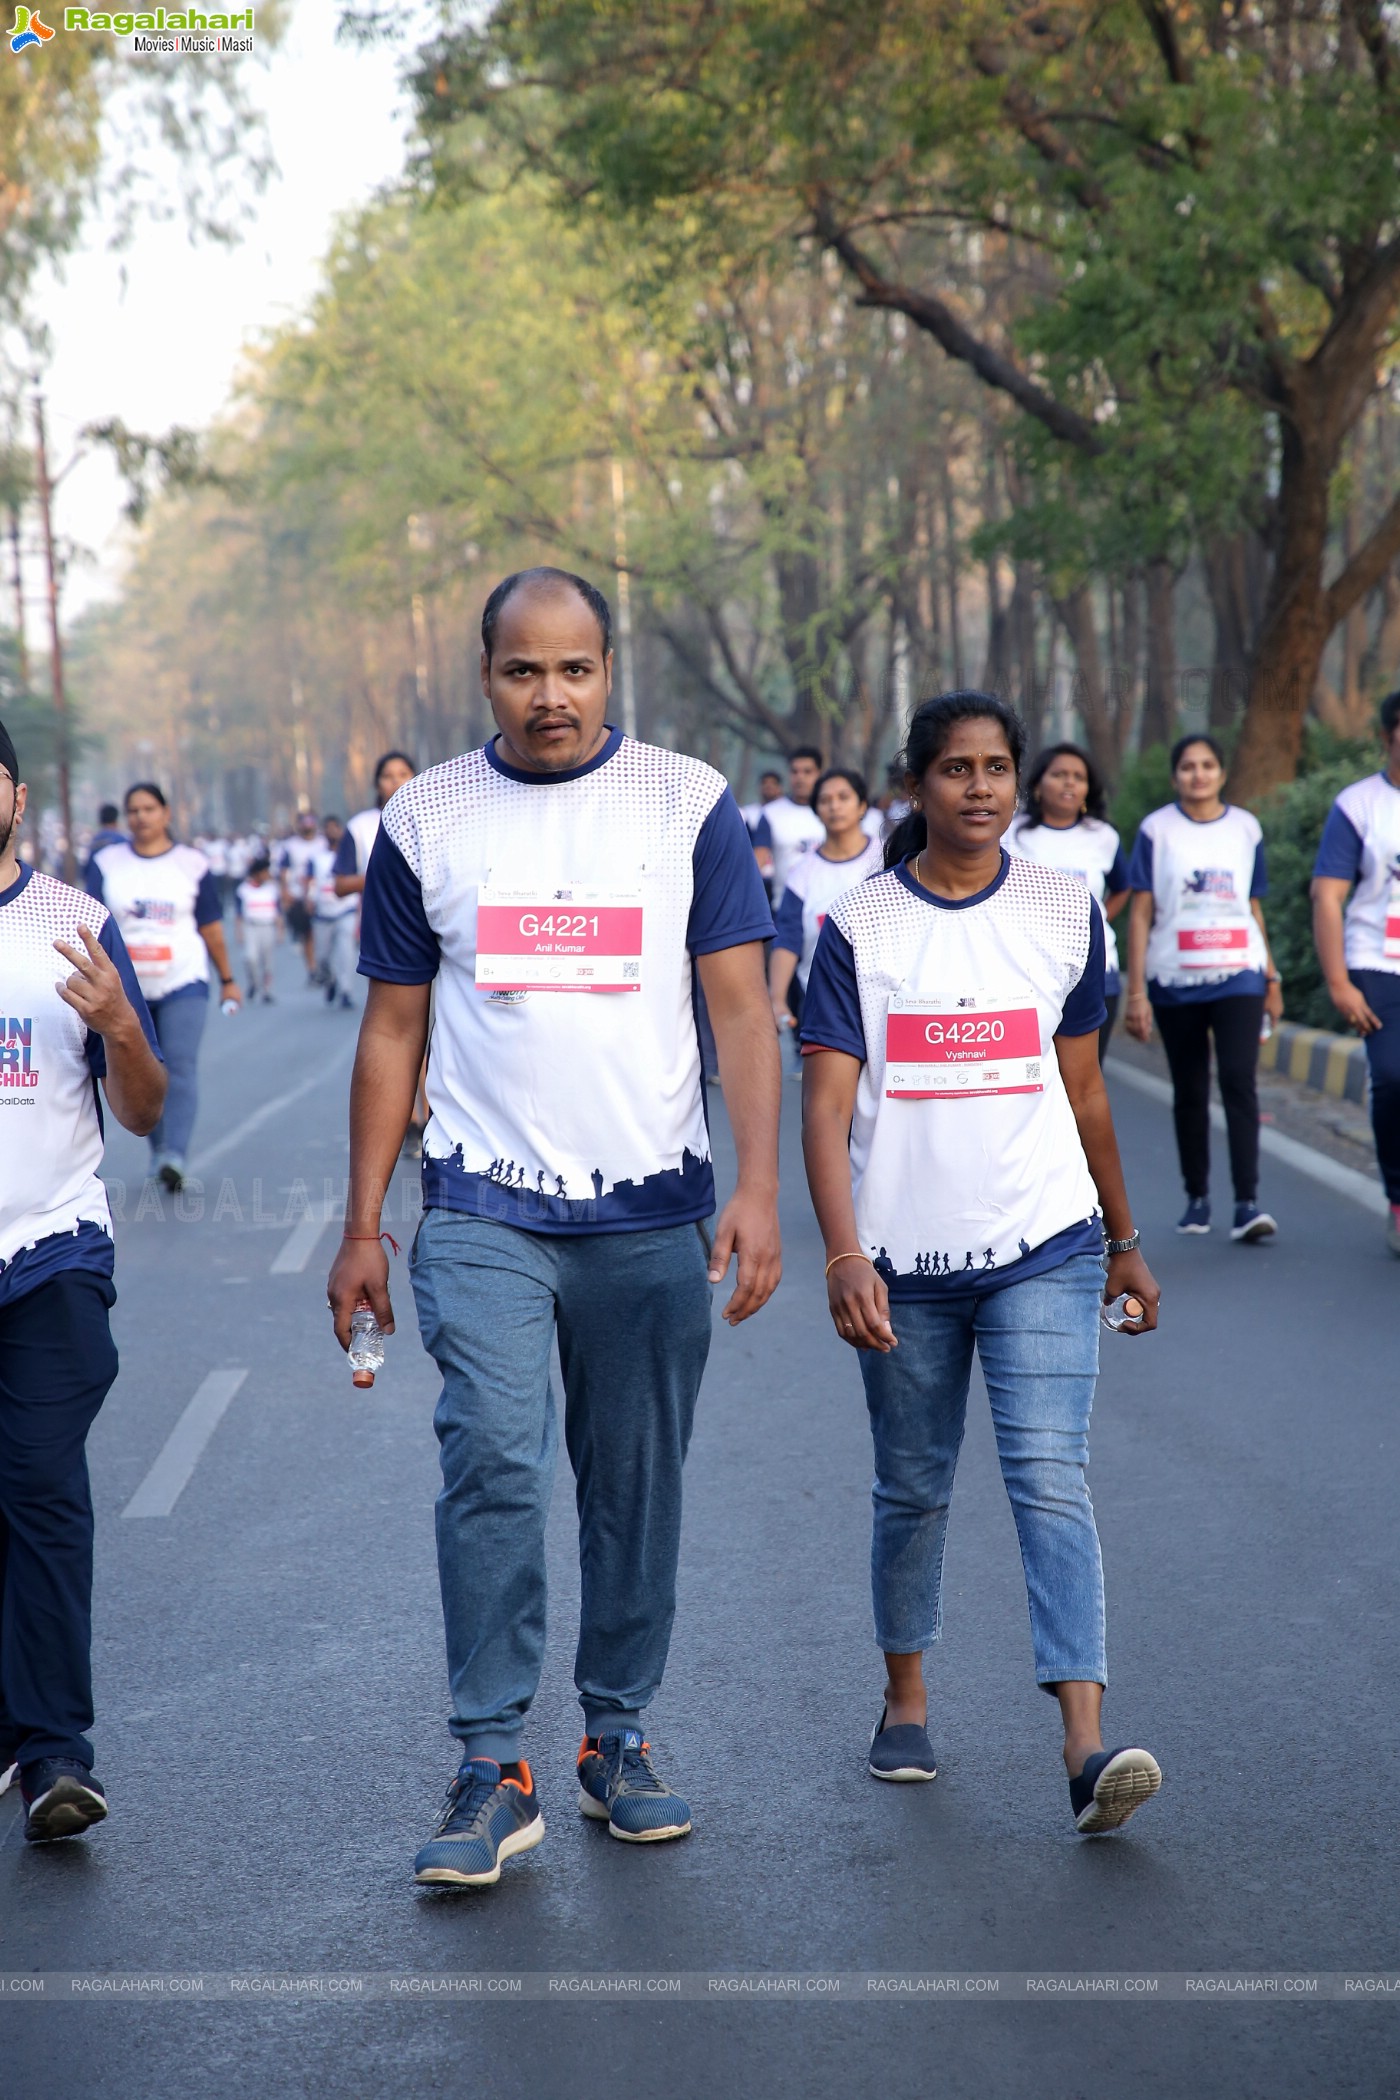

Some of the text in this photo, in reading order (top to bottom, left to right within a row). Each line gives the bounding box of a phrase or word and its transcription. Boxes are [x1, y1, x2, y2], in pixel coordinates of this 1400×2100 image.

[519, 914, 599, 937] G4221
[535, 943, 586, 953] Anil Kumar
[483, 967, 495, 976] B+
[925, 1019, 1005, 1044] G4220
[945, 1049, 986, 1061] Vyshnavi
[0, 1073, 38, 1087] HILD
